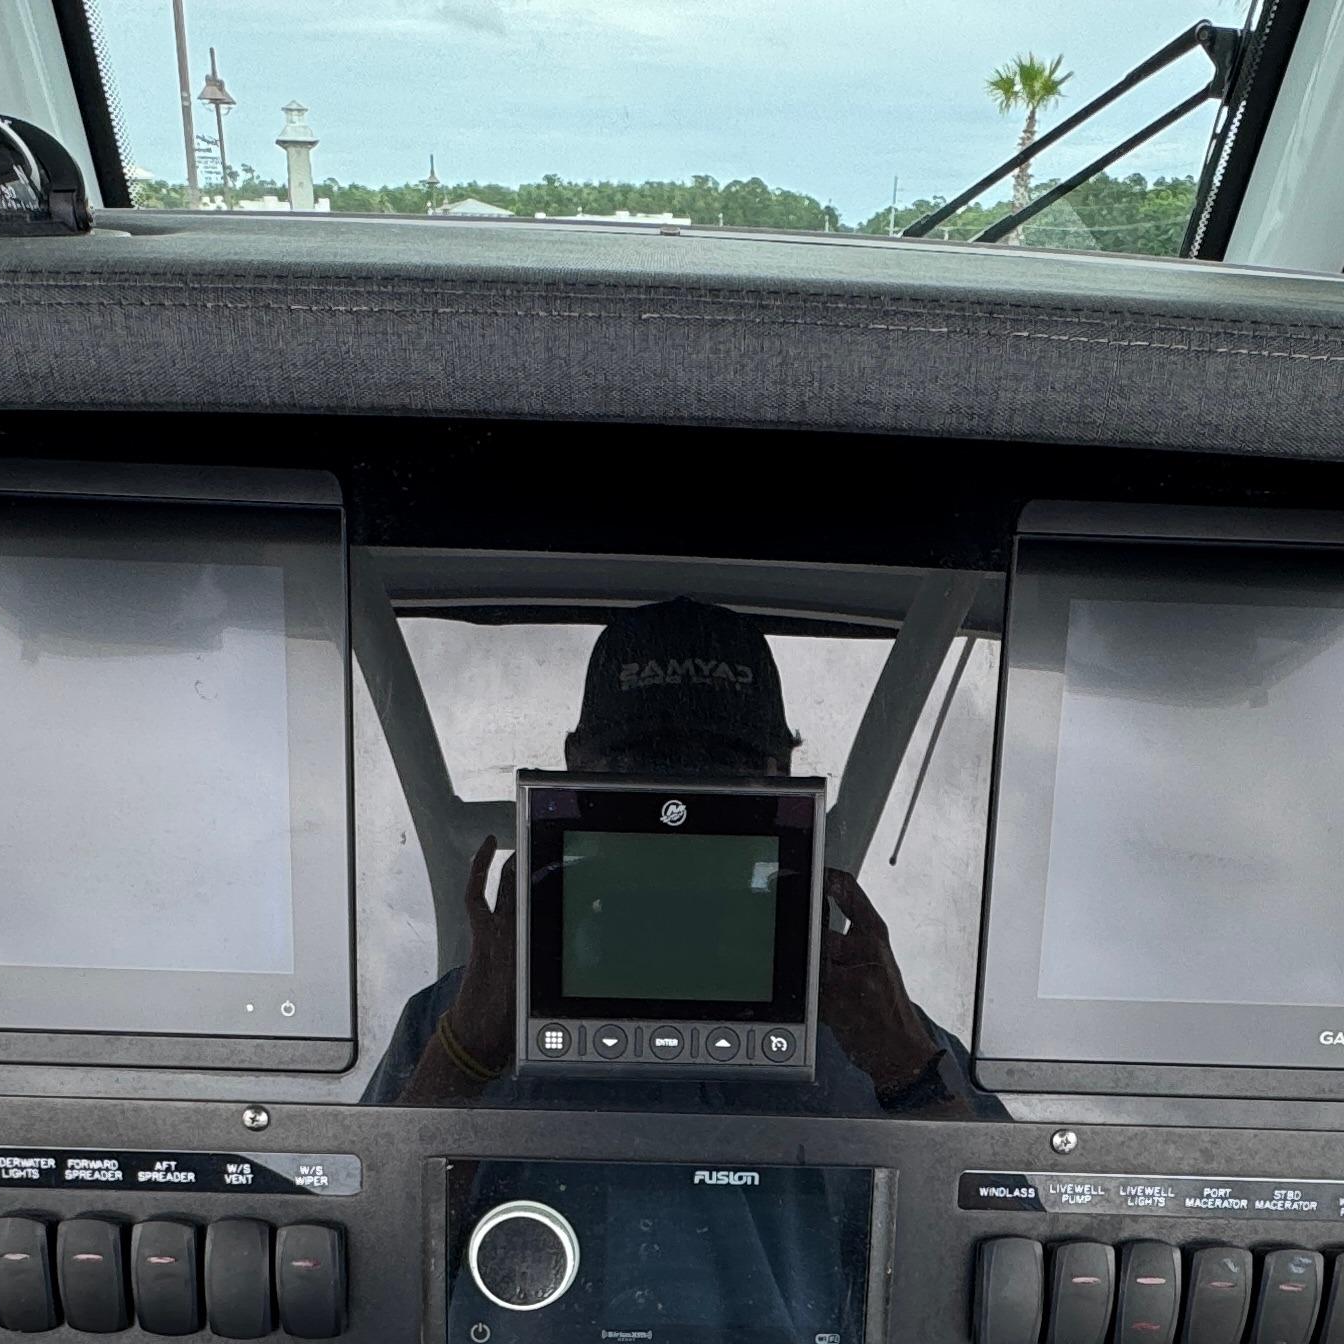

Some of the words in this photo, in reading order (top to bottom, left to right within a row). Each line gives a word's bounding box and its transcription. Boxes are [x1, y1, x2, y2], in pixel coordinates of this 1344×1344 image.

[67, 1159, 119, 1170] FORWARD
[154, 1162, 177, 1172] AFT
[226, 1164, 251, 1174] W/S
[1, 1168, 40, 1180] LIGHTS
[64, 1170, 123, 1181] SPREADER
[299, 1165, 323, 1176] W/S
[137, 1171, 195, 1183] SPREADER
[224, 1174, 253, 1185] VENT
[295, 1176, 329, 1187] WIPER
[979, 1187, 1035, 1198] WINDLASS
[1049, 1184, 1105, 1195] LIVEWELL
[1119, 1186, 1175, 1198] LIVEWELL
[1203, 1188, 1232, 1198] PORT
[1273, 1190, 1302, 1200] STBD
[1061, 1195, 1092, 1204] PUMP
[1127, 1197, 1166, 1208] LIGHTS
[1185, 1198, 1248, 1209] MACERATOR
[1255, 1200, 1318, 1212] MACERATOR
